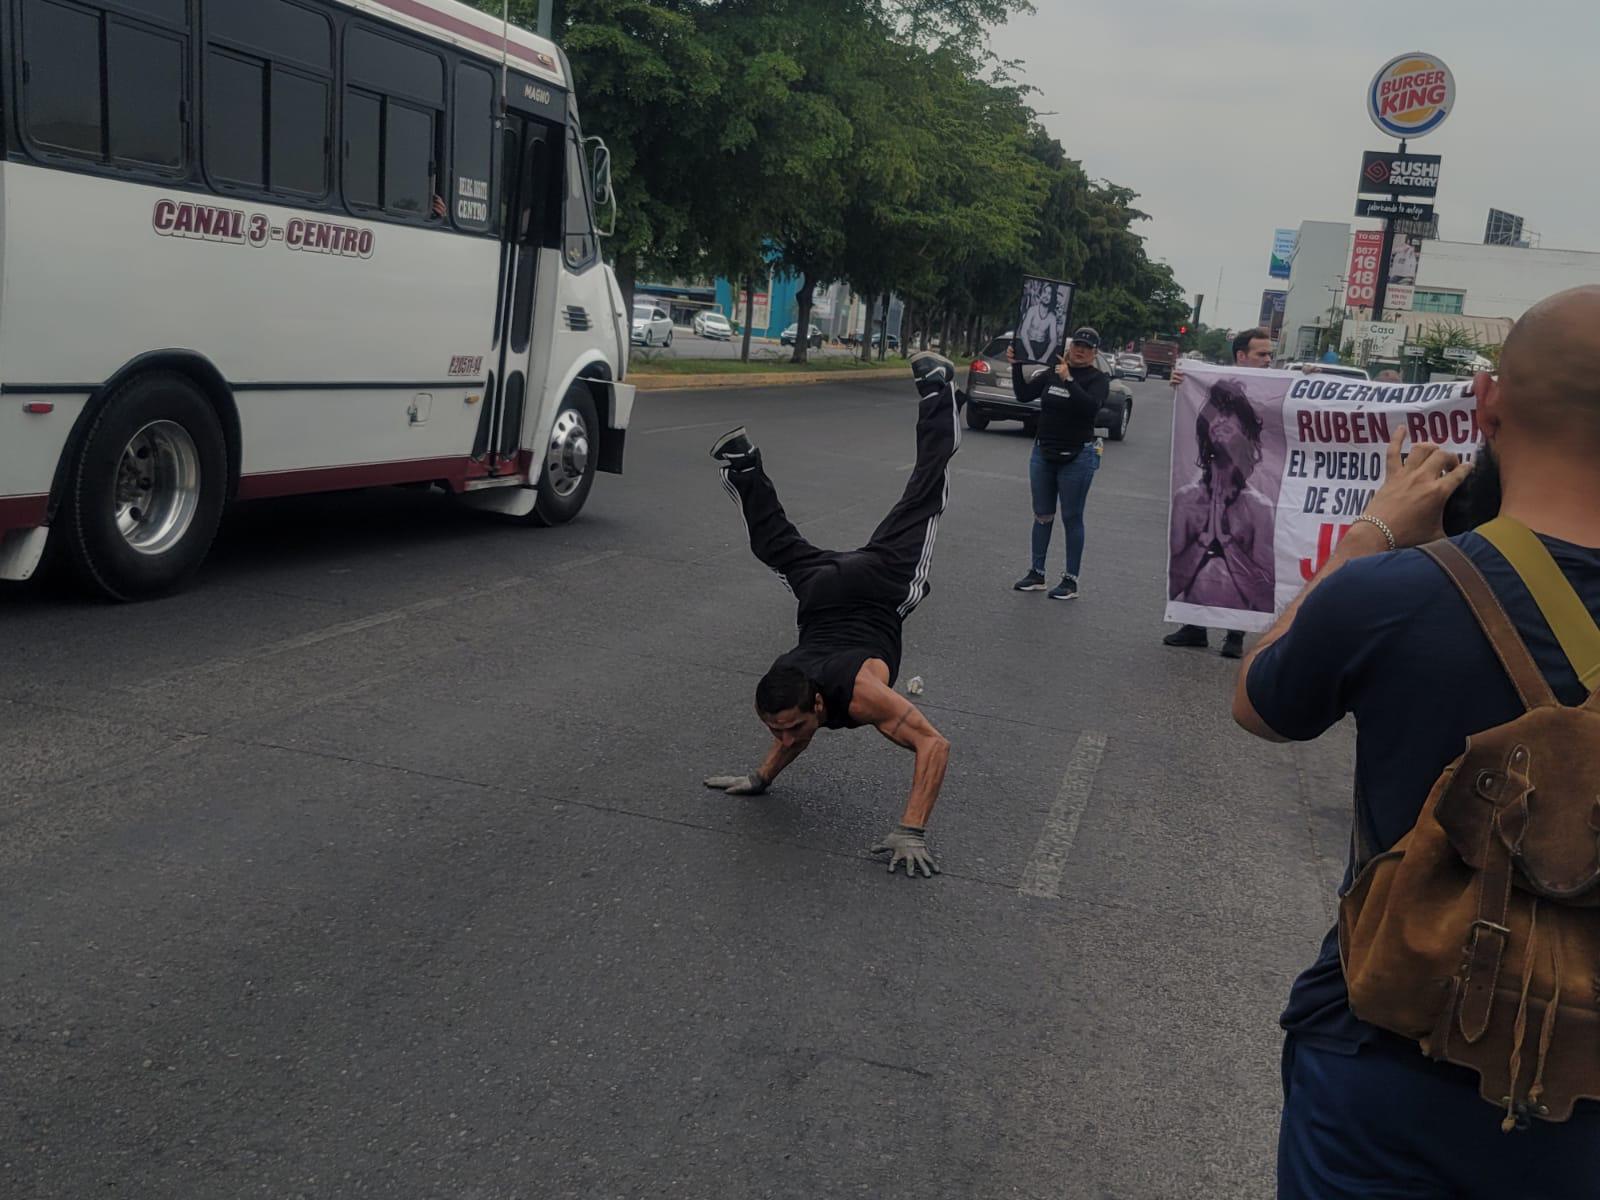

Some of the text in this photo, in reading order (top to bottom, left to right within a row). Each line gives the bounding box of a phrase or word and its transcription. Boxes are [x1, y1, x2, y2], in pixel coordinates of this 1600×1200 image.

[1381, 71, 1445, 96] BURGER
[1380, 84, 1446, 117] KING
[1390, 161, 1440, 177] SUSHI
[1389, 175, 1437, 187] FACTORY
[458, 199, 487, 222] CENTRO
[154, 200, 245, 241] CANAL
[250, 215, 267, 244] 3
[286, 218, 373, 256] CENTRO
[1355, 255, 1376, 270] 16
[1353, 270, 1374, 285] 18
[1348, 285, 1374, 300] 00
[1370, 325, 1394, 334] Casa
[1290, 379, 1455, 403] GOBERNADOR
[1297, 405, 1391, 444] RUBÉN
[1287, 450, 1308, 477] EL
[1313, 451, 1381, 481] PUEBLO
[1303, 486, 1329, 514] DE
